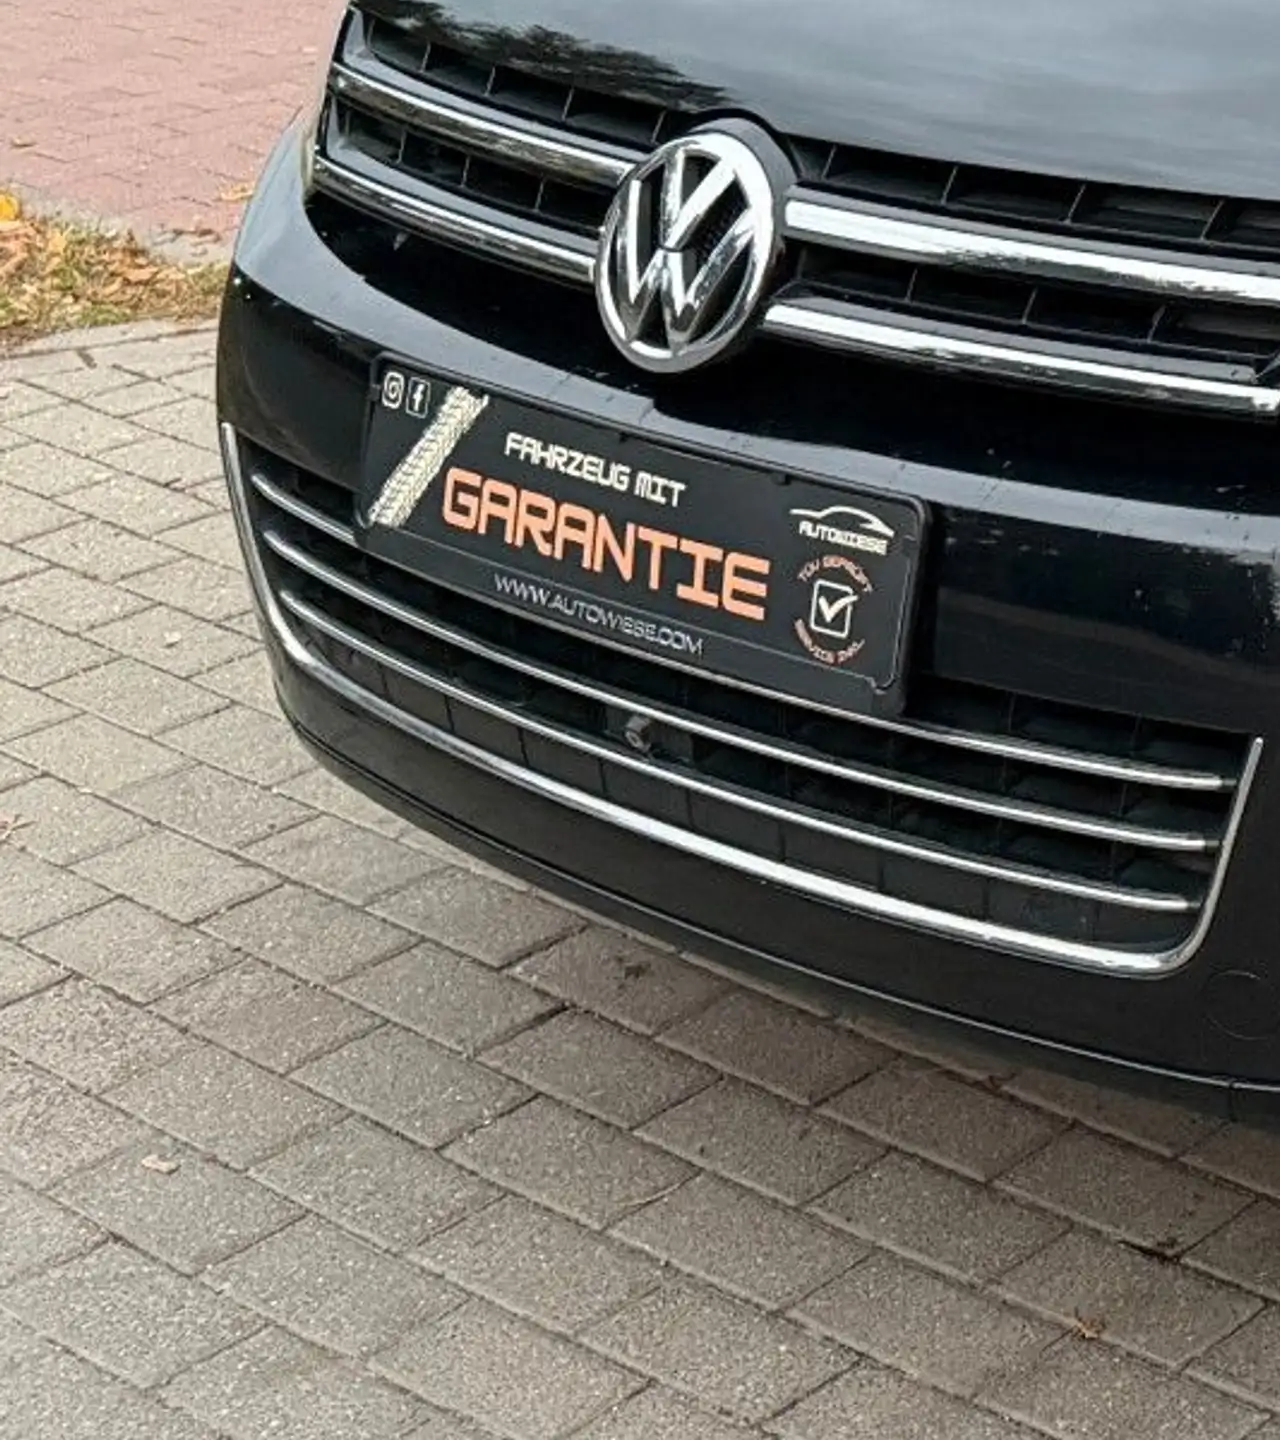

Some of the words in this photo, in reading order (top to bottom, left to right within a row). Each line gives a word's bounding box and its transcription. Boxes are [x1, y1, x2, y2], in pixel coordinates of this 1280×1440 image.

[503, 431, 632, 493] FAHRZEUG
[633, 471, 688, 508] MIT
[441, 466, 771, 621] GARANTIE
